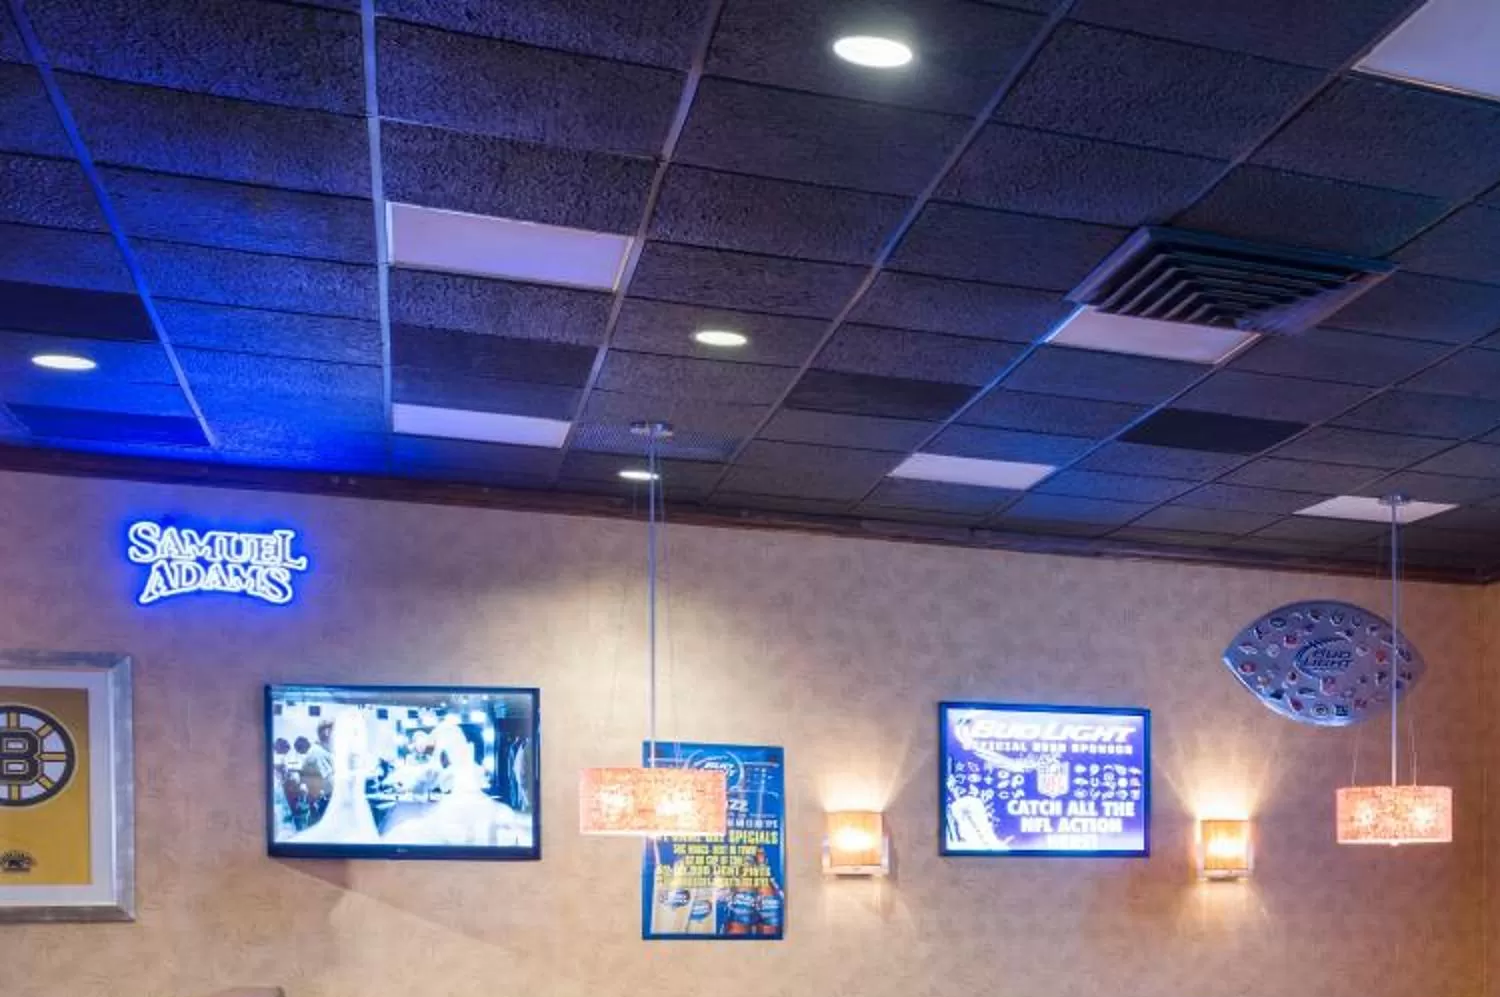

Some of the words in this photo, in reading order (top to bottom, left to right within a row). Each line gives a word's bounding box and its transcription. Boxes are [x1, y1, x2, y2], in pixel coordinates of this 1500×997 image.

[127, 521, 308, 570] SAMUEL
[139, 558, 293, 604] ADAMS
[1313, 649, 1351, 659] BUD
[971, 719, 1043, 740] BUD
[1044, 722, 1137, 743] LIGHT
[1007, 798, 1062, 816] CATCH
[1067, 799, 1099, 816] ALL
[1101, 800, 1135, 817] THE
[1020, 816, 1053, 833] NFL
[1057, 817, 1123, 833] ACTION
